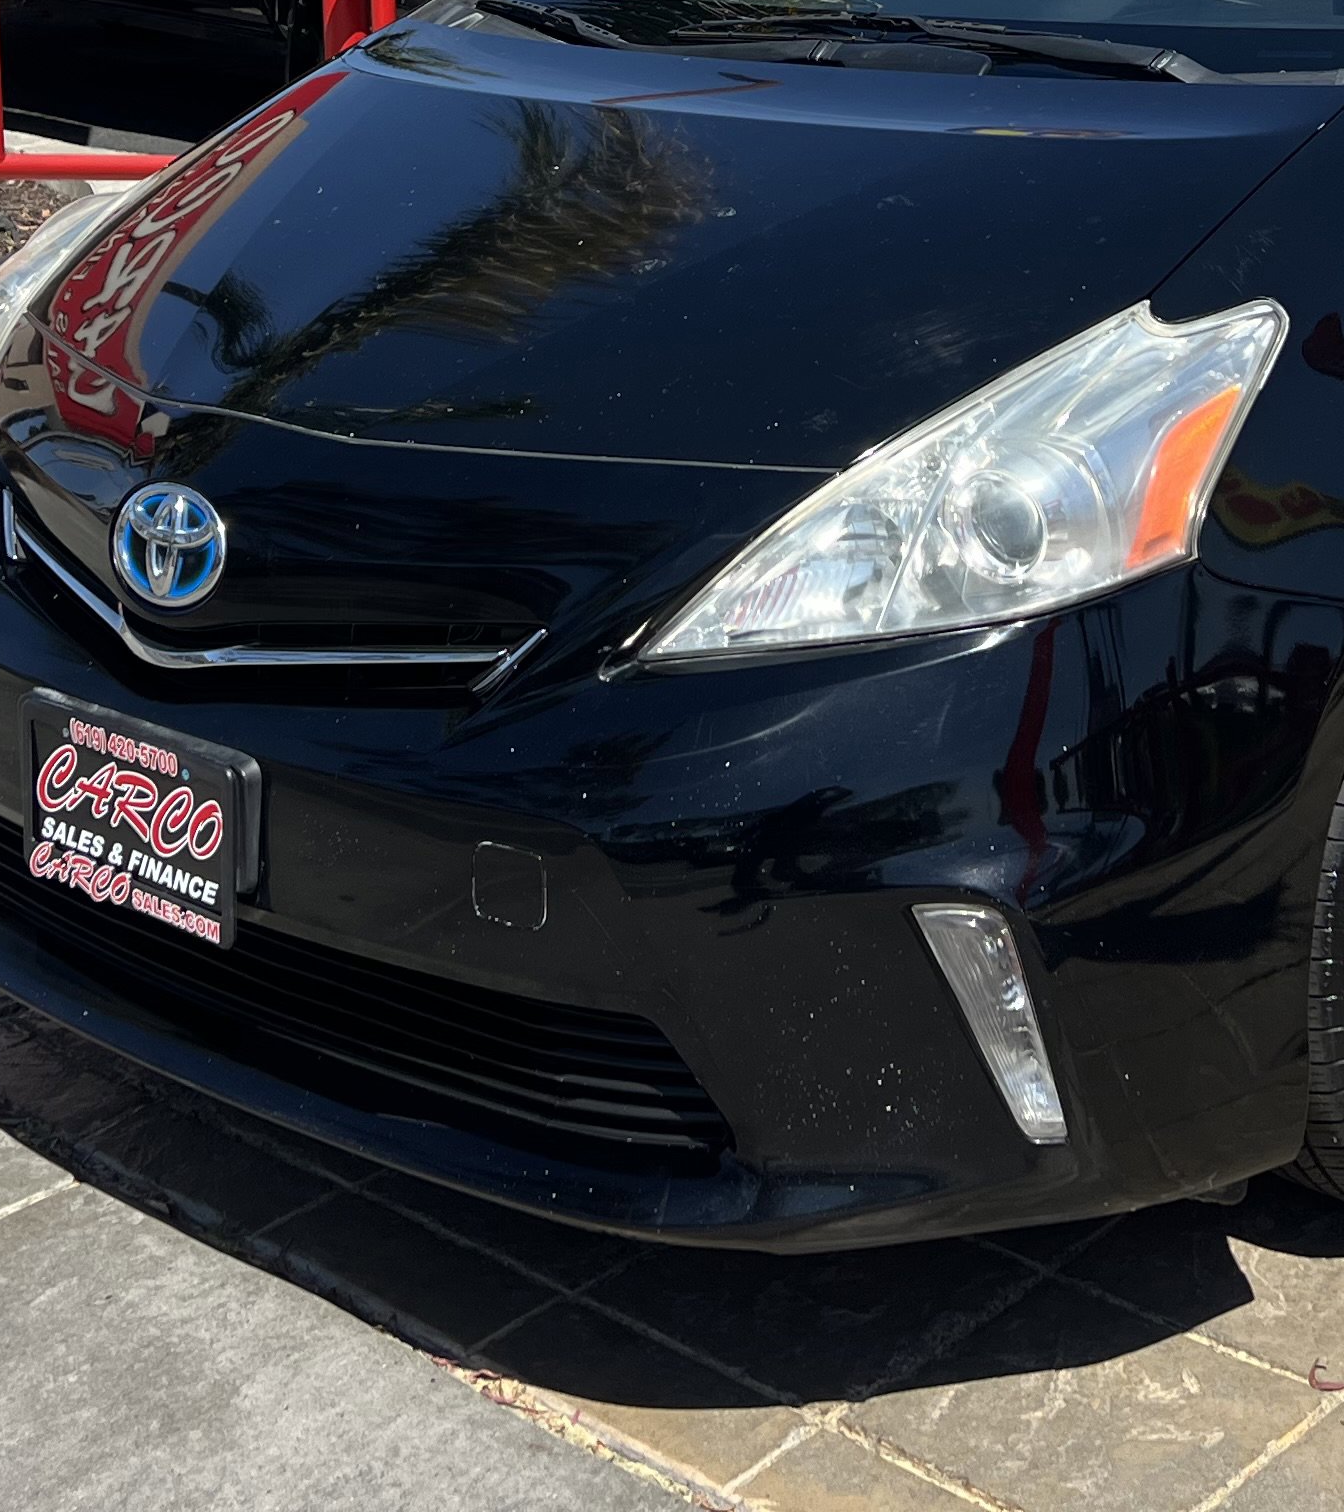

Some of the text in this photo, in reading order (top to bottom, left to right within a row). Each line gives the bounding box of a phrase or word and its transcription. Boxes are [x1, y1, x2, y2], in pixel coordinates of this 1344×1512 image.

[69, 718, 107, 753] (619)
[37, 744, 223, 860] CARCO
[29, 841, 132, 905] CARCO
[41, 817, 219, 905] SALES & FINANCE
